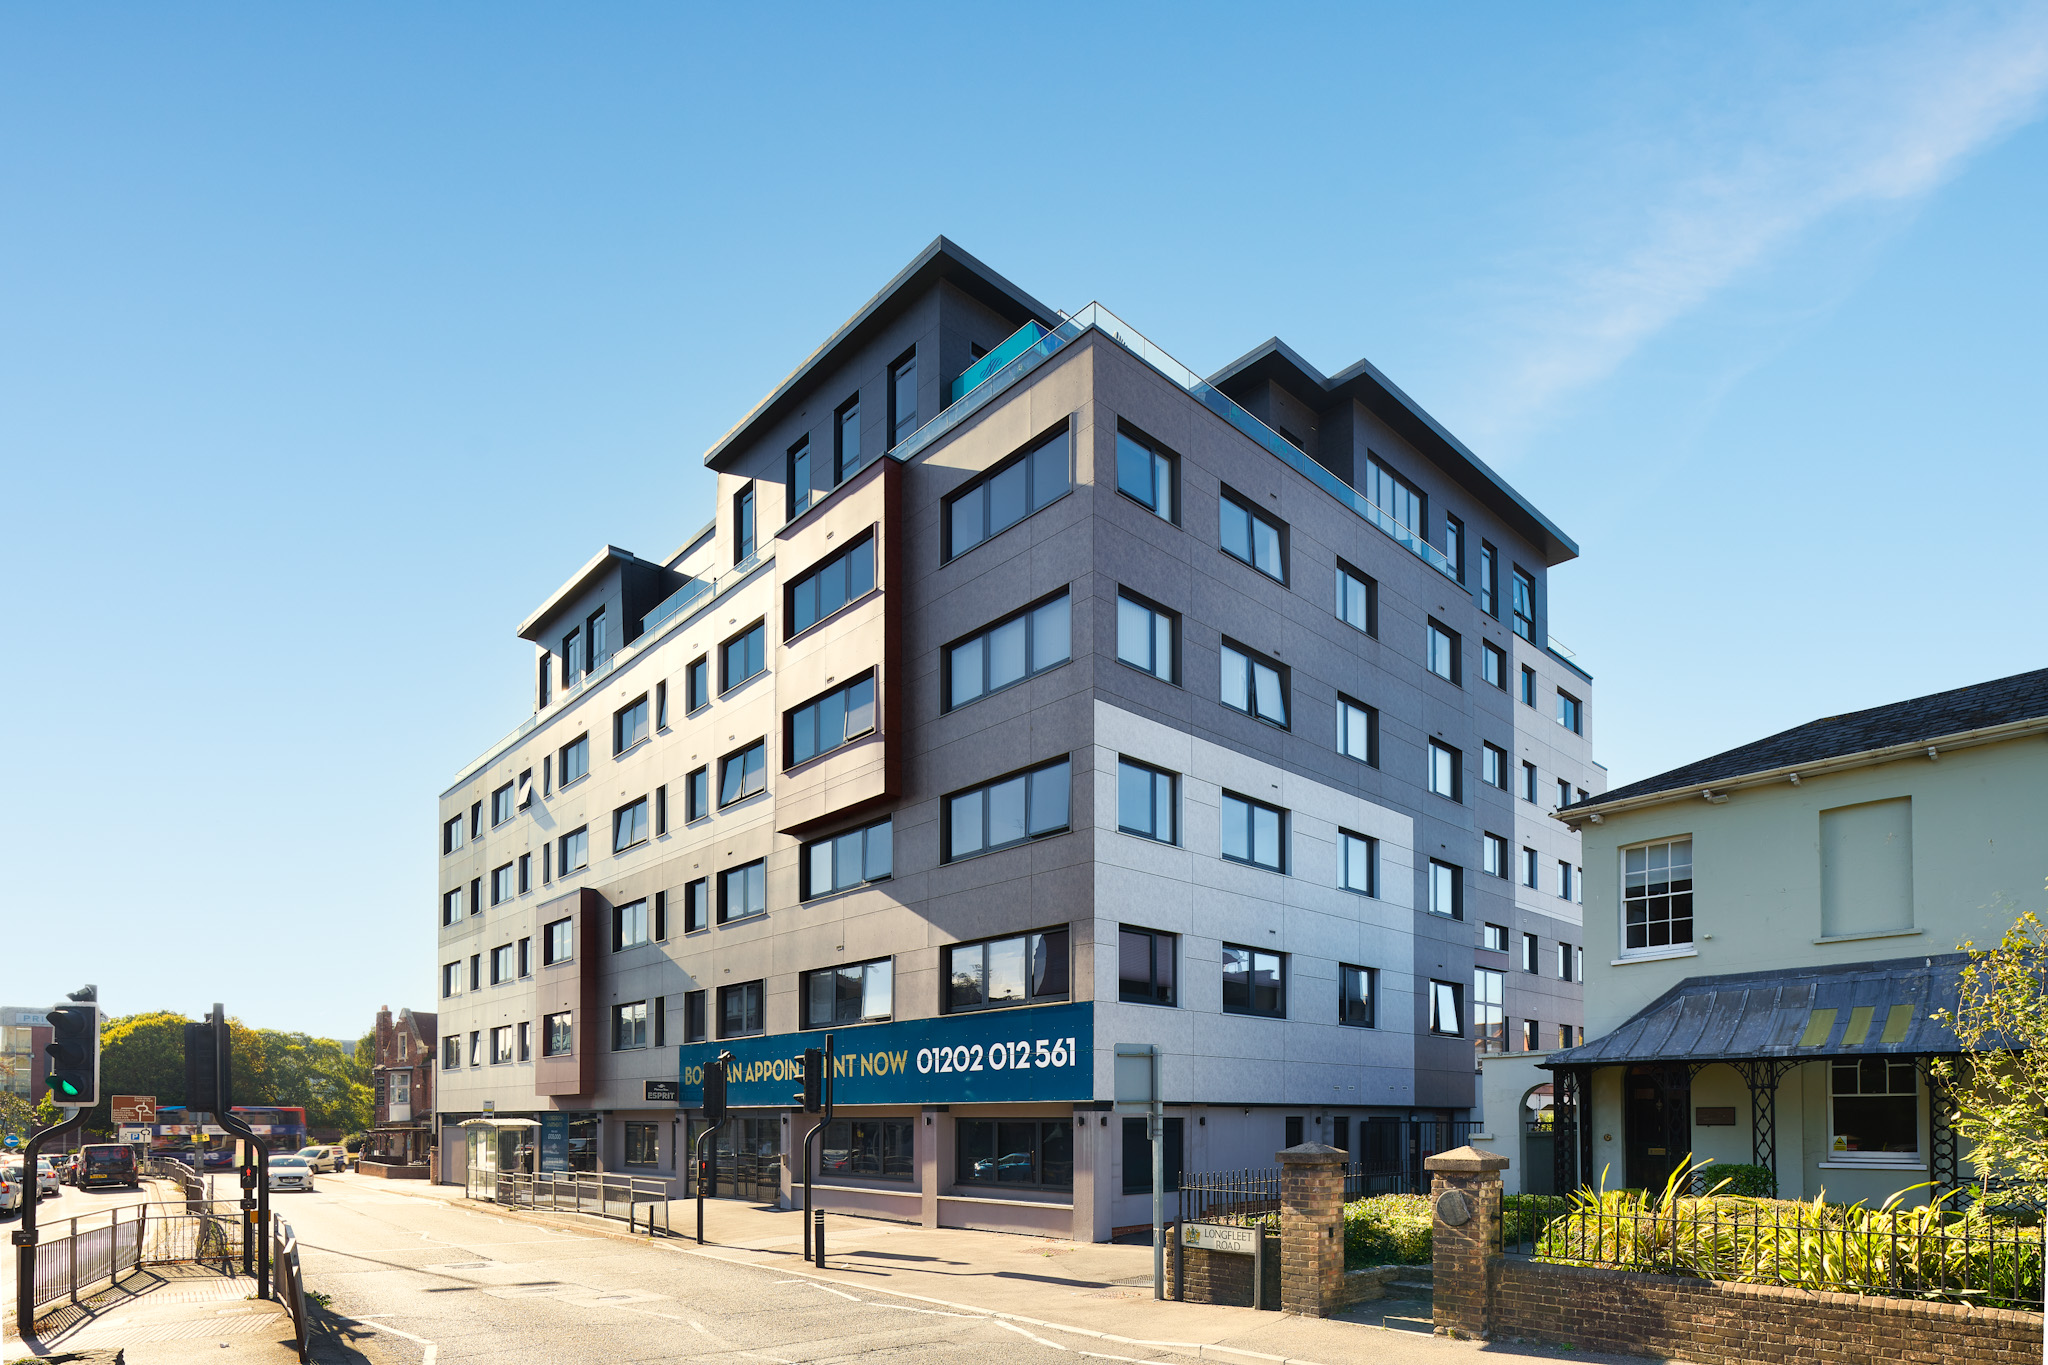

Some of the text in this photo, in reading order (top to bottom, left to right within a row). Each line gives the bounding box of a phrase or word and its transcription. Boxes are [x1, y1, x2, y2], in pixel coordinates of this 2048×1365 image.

[745, 1053, 857, 1083] APPOINNT
[860, 1050, 908, 1077] NOW
[916, 1044, 984, 1074] 01202
[988, 1040, 1031, 1071] 012
[1034, 1037, 1076, 1068] 561
[647, 1091, 675, 1100] ESPRIT
[186, 1152, 219, 1161] mre
[1204, 1229, 1252, 1241] LONGFLEET
[1216, 1241, 1240, 1250] ROAD
